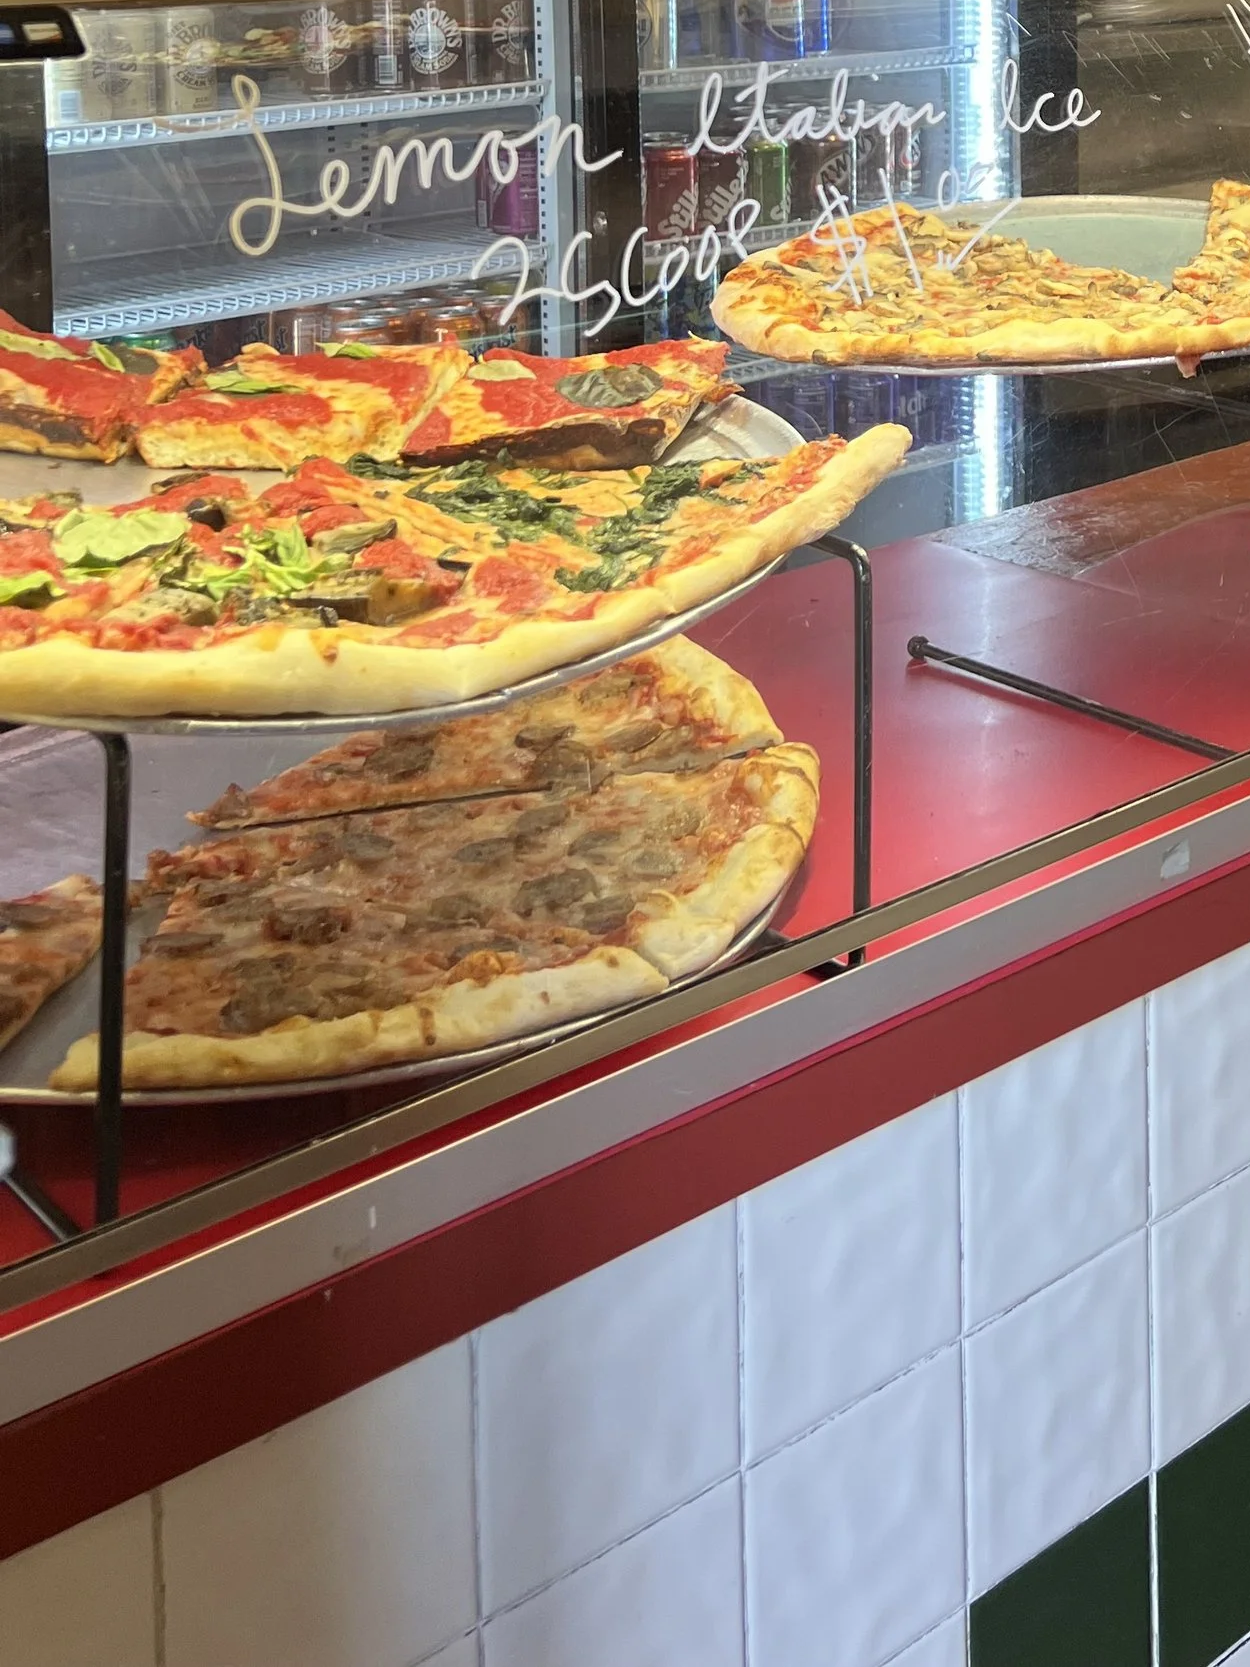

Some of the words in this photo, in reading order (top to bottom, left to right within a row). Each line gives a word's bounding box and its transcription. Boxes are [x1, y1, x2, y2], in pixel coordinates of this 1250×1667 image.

[228, 74, 626, 256] Lemon
[688, 61, 947, 155] Italian
[999, 58, 1101, 134] Ice
